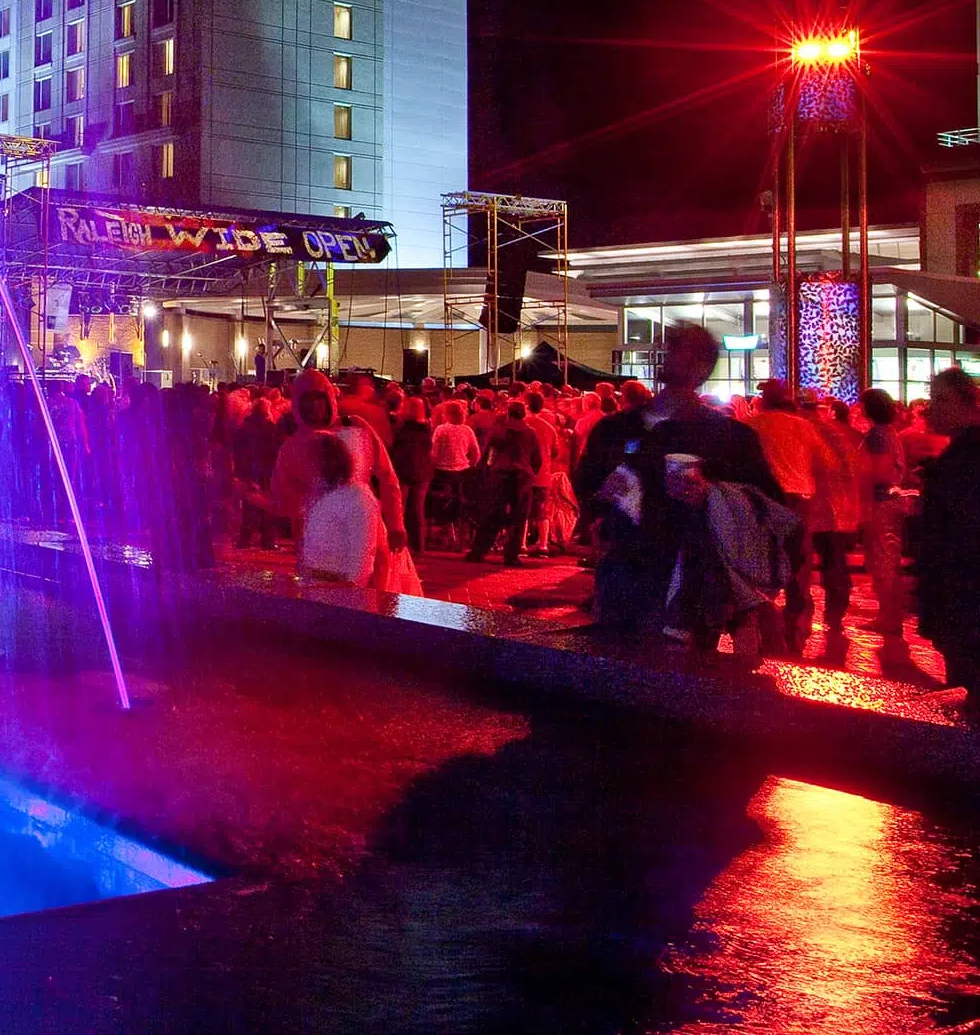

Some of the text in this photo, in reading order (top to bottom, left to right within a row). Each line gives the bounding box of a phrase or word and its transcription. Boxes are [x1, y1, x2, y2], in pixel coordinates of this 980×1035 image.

[56, 207, 376, 261] RALEIGH WIDE OPEN
